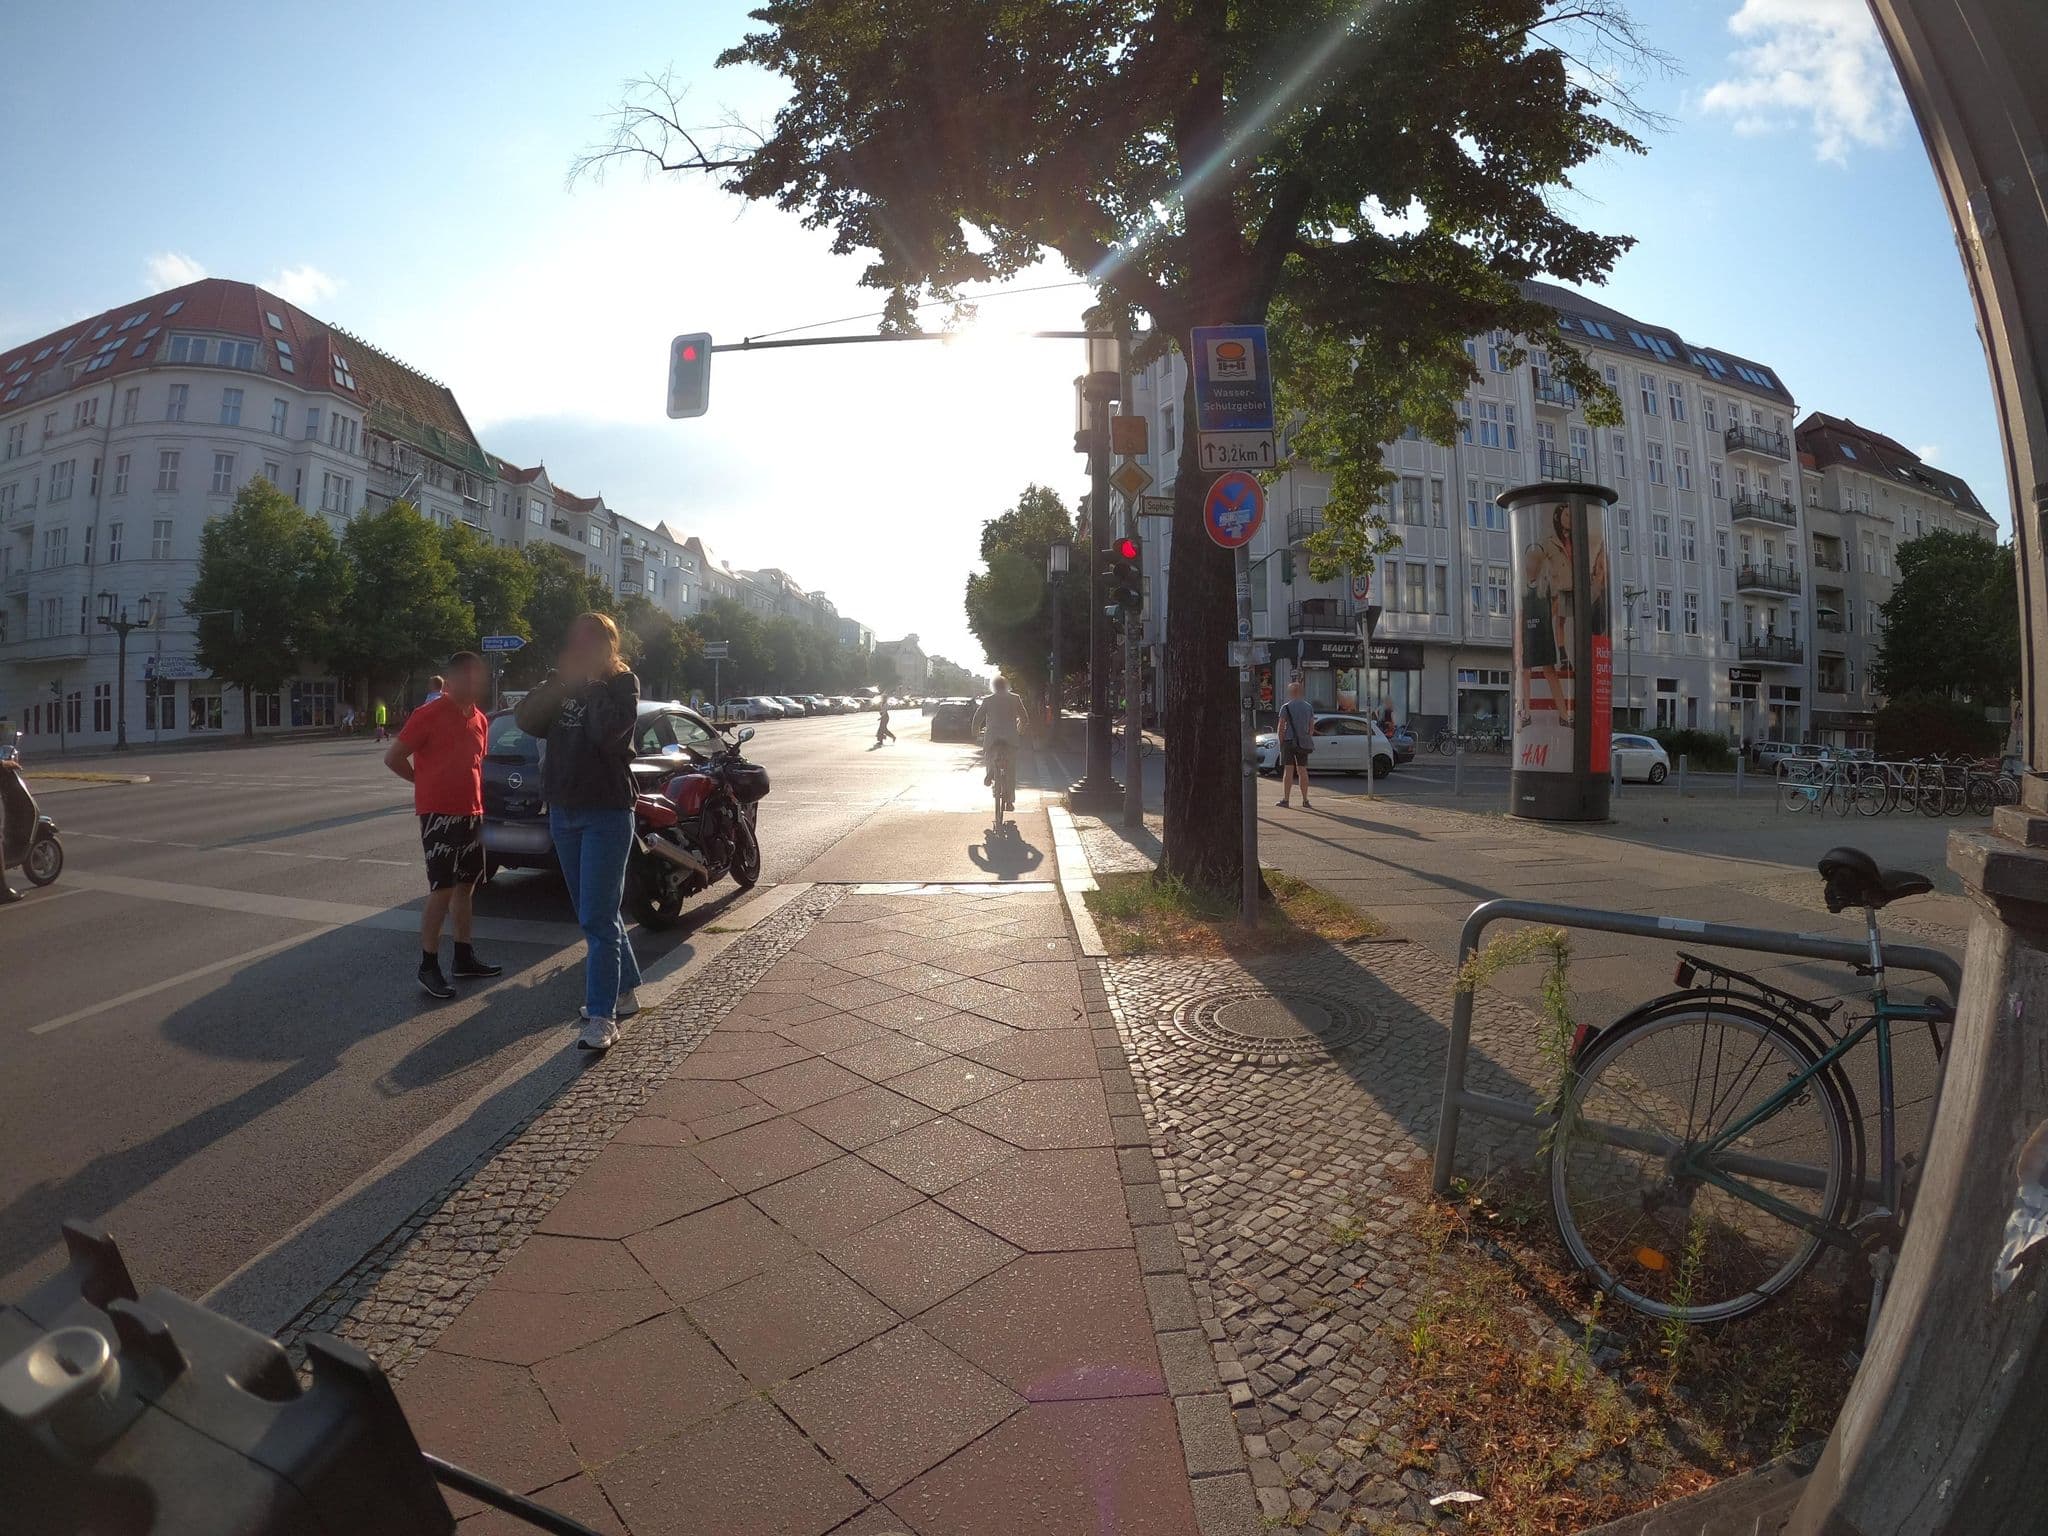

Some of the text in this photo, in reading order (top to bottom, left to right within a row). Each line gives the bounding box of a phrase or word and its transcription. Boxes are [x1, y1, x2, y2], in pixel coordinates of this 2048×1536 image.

[1213, 387, 1255, 398] Wasser-
[1203, 400, 1266, 412] Schutzgebiet
[1321, 643, 1355, 652] BEAUTY
[1521, 743, 1549, 767] H&M
